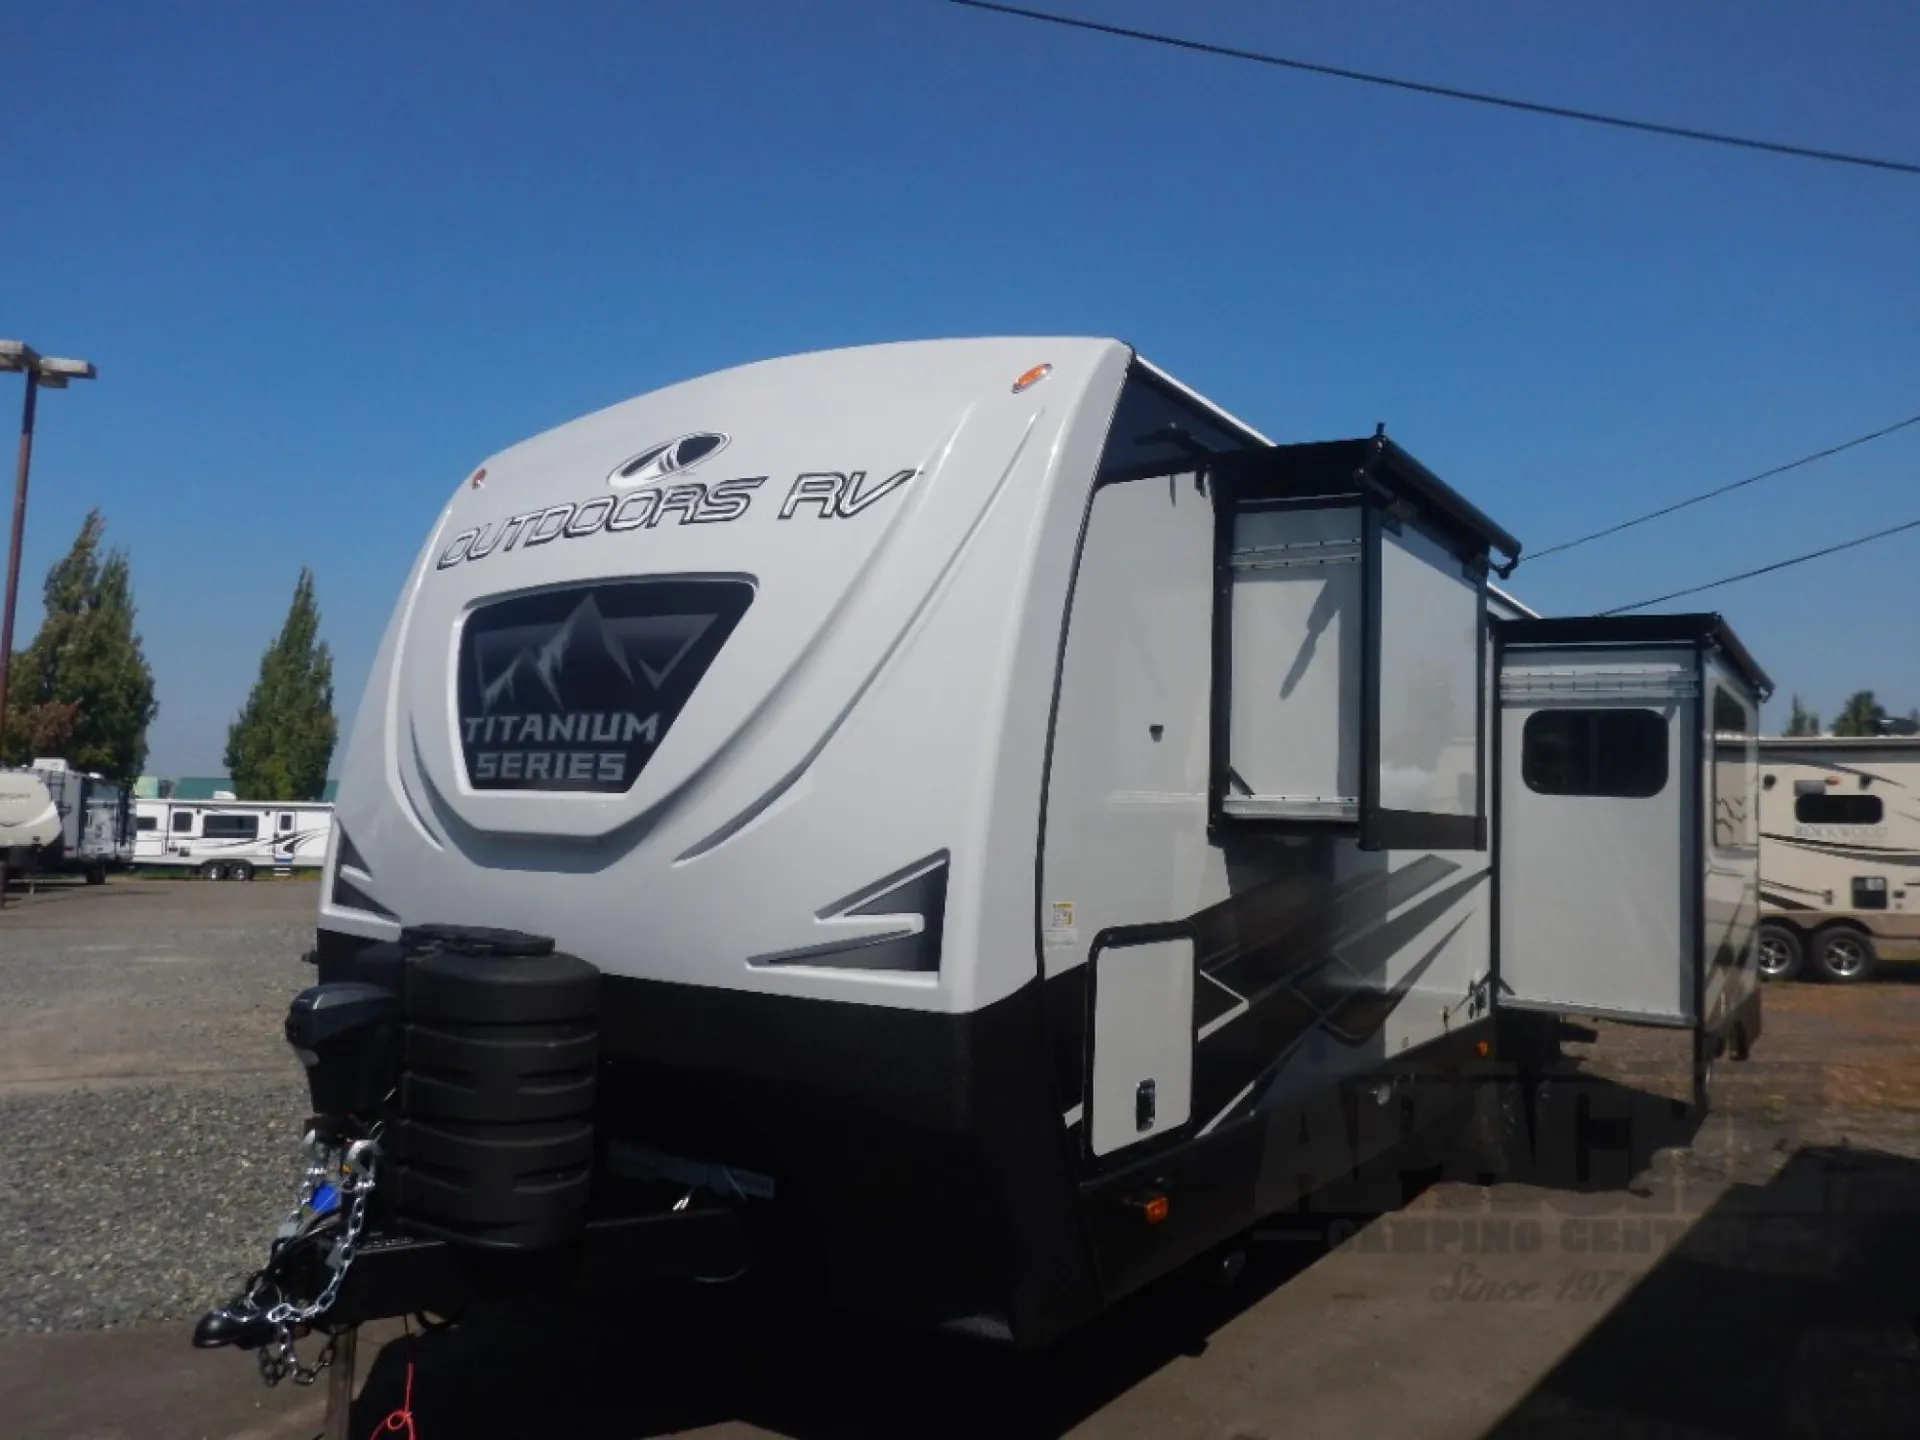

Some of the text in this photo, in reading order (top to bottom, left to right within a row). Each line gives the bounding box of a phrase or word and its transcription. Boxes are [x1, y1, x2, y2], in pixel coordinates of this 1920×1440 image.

[437, 469, 918, 570] OUTDOORS RV
[464, 711, 661, 743] TITANIUM
[475, 752, 628, 782] SERIES
